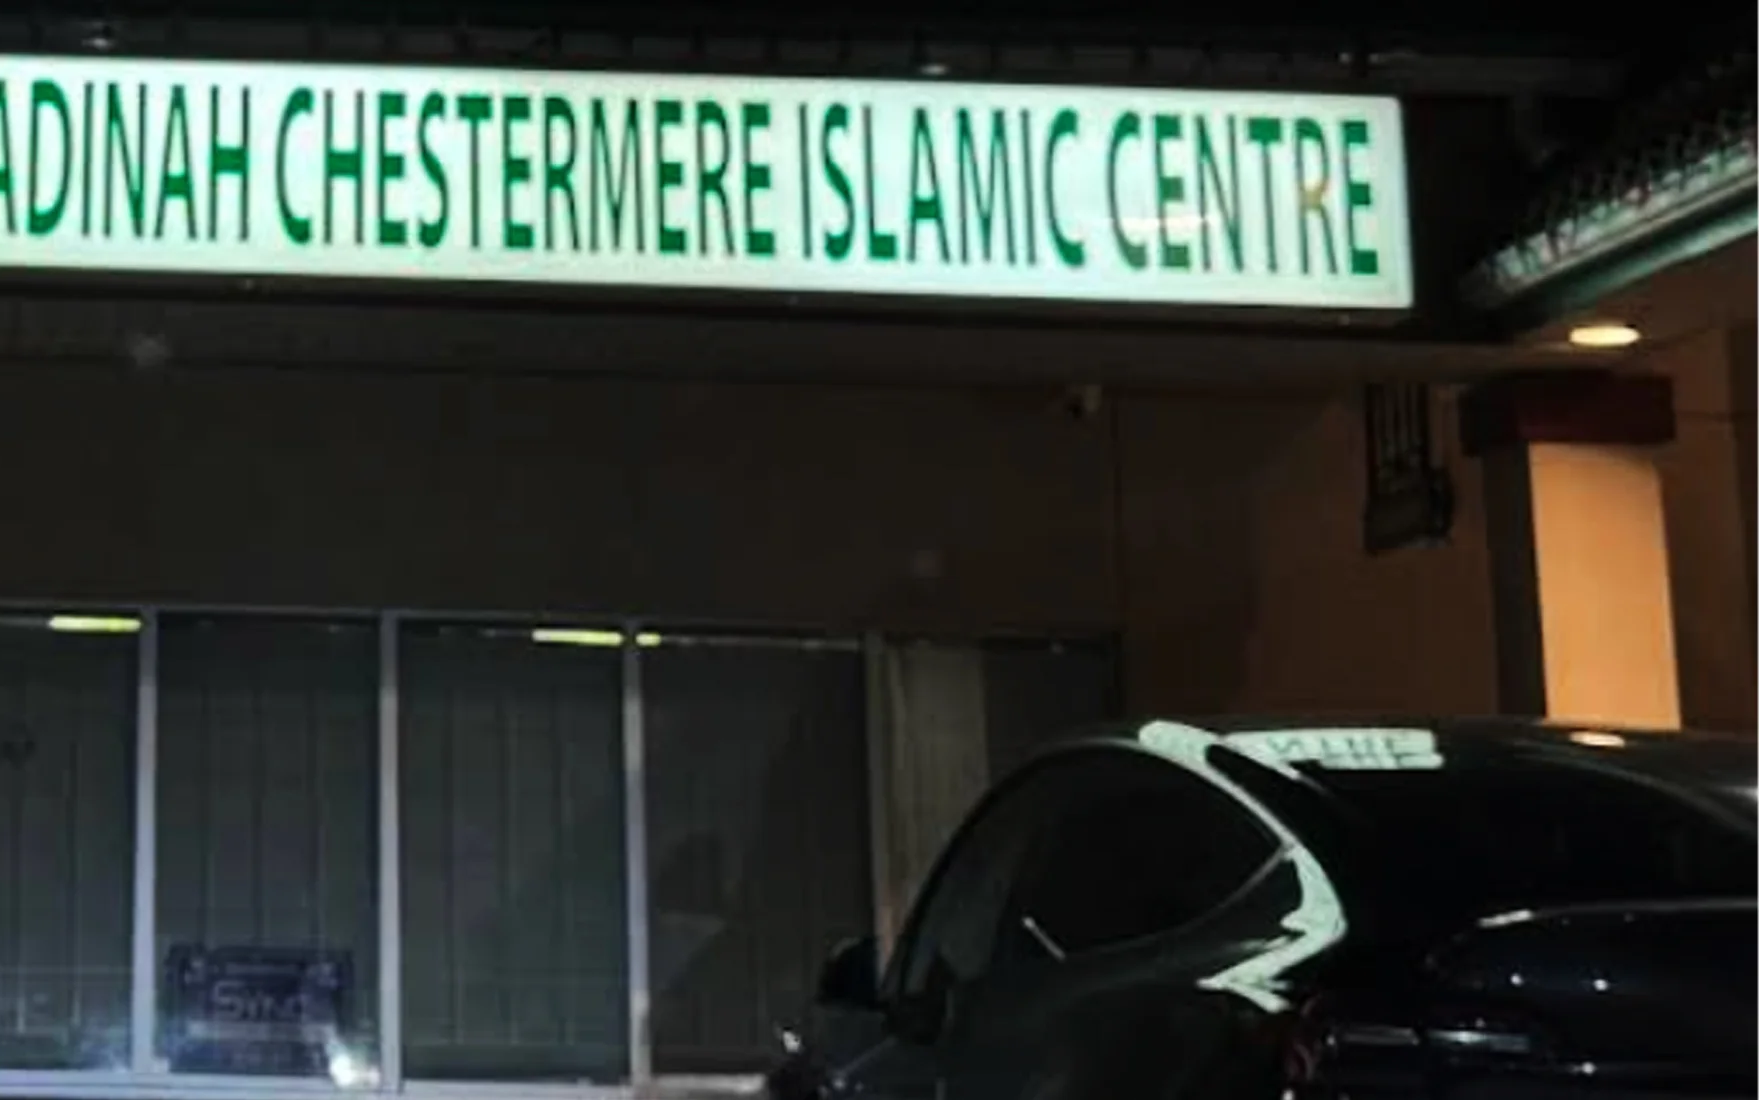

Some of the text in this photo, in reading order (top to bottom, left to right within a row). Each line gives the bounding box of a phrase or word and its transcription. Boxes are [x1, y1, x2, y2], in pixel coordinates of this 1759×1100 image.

[275, 87, 776, 259] CHESTERMERE
[798, 103, 1086, 268] ISLAMIC
[1106, 110, 1380, 276] CENTRE
